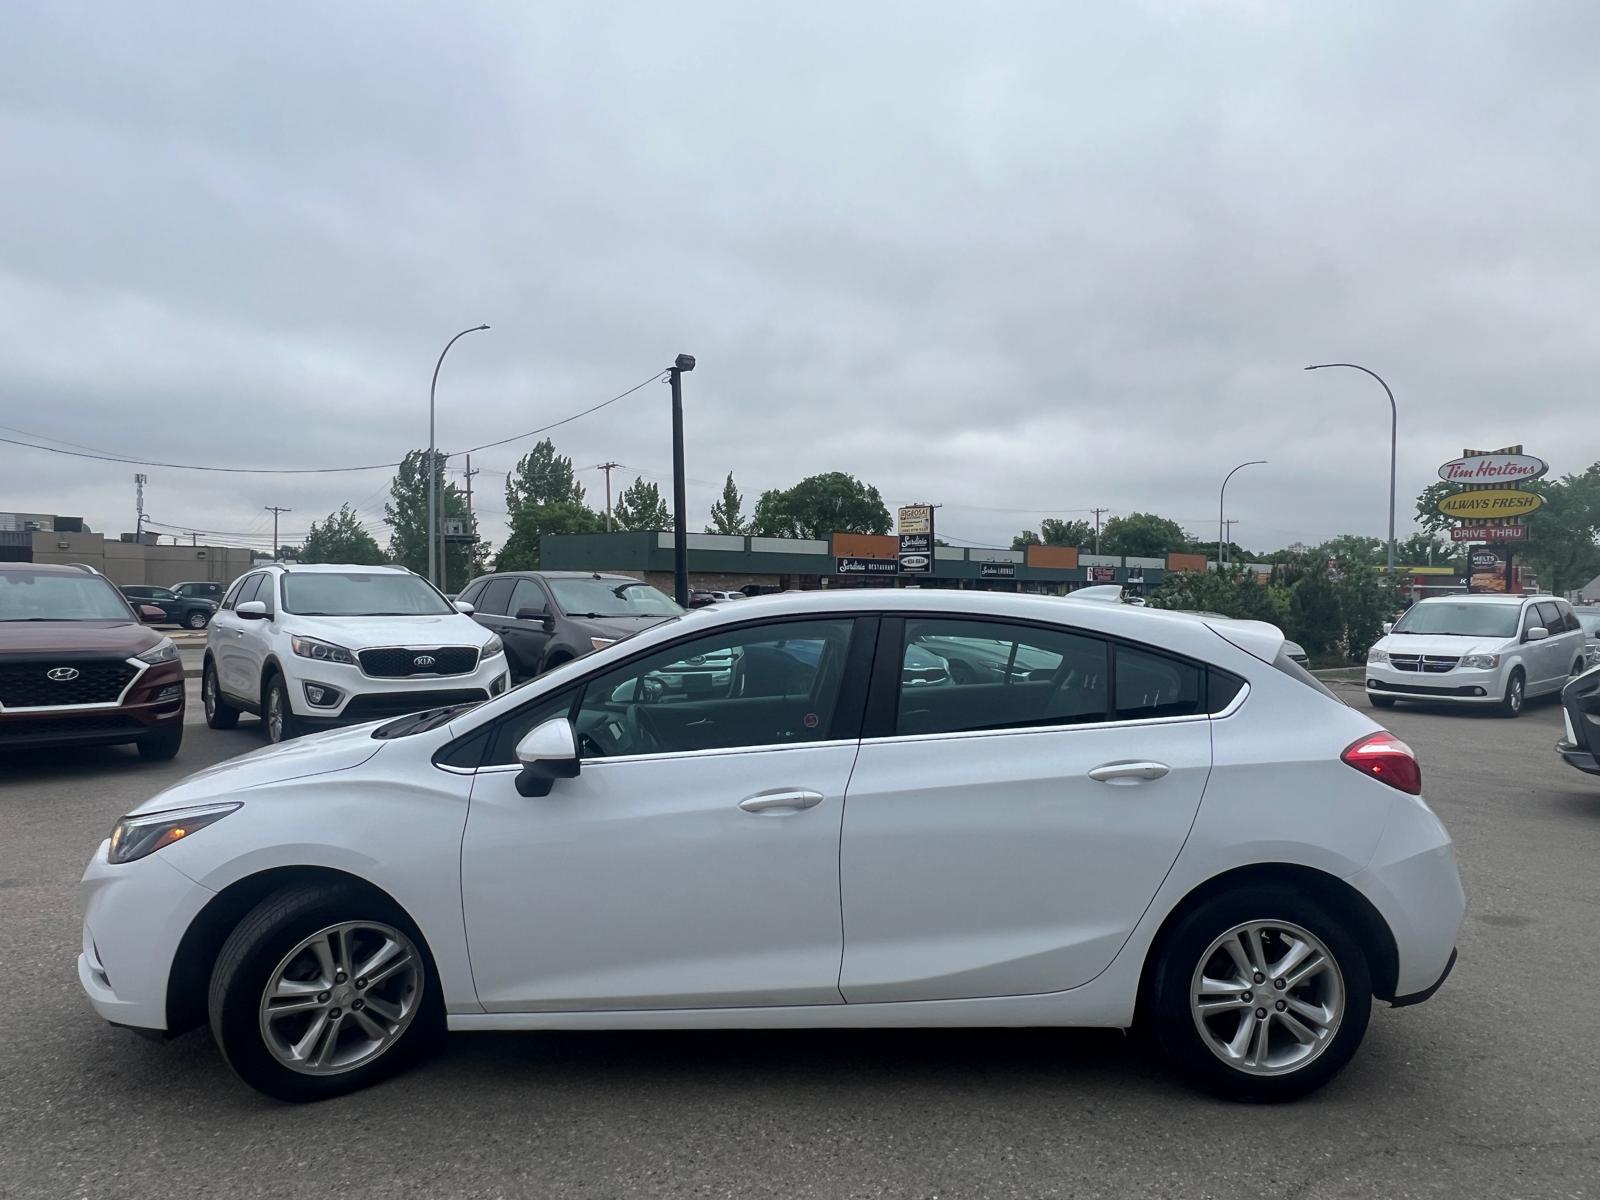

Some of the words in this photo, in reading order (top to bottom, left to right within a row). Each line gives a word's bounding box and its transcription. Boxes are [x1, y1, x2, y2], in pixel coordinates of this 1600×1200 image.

[1446, 462, 1474, 479] Tim
[1475, 460, 1535, 478] Hortons
[1443, 498, 1490, 511] ALWAYS
[1491, 496, 1535, 509] FRESH
[1453, 529, 1487, 539] DRIVE
[1490, 528, 1522, 538] THRU
[868, 563, 896, 571] RESTAURANT
